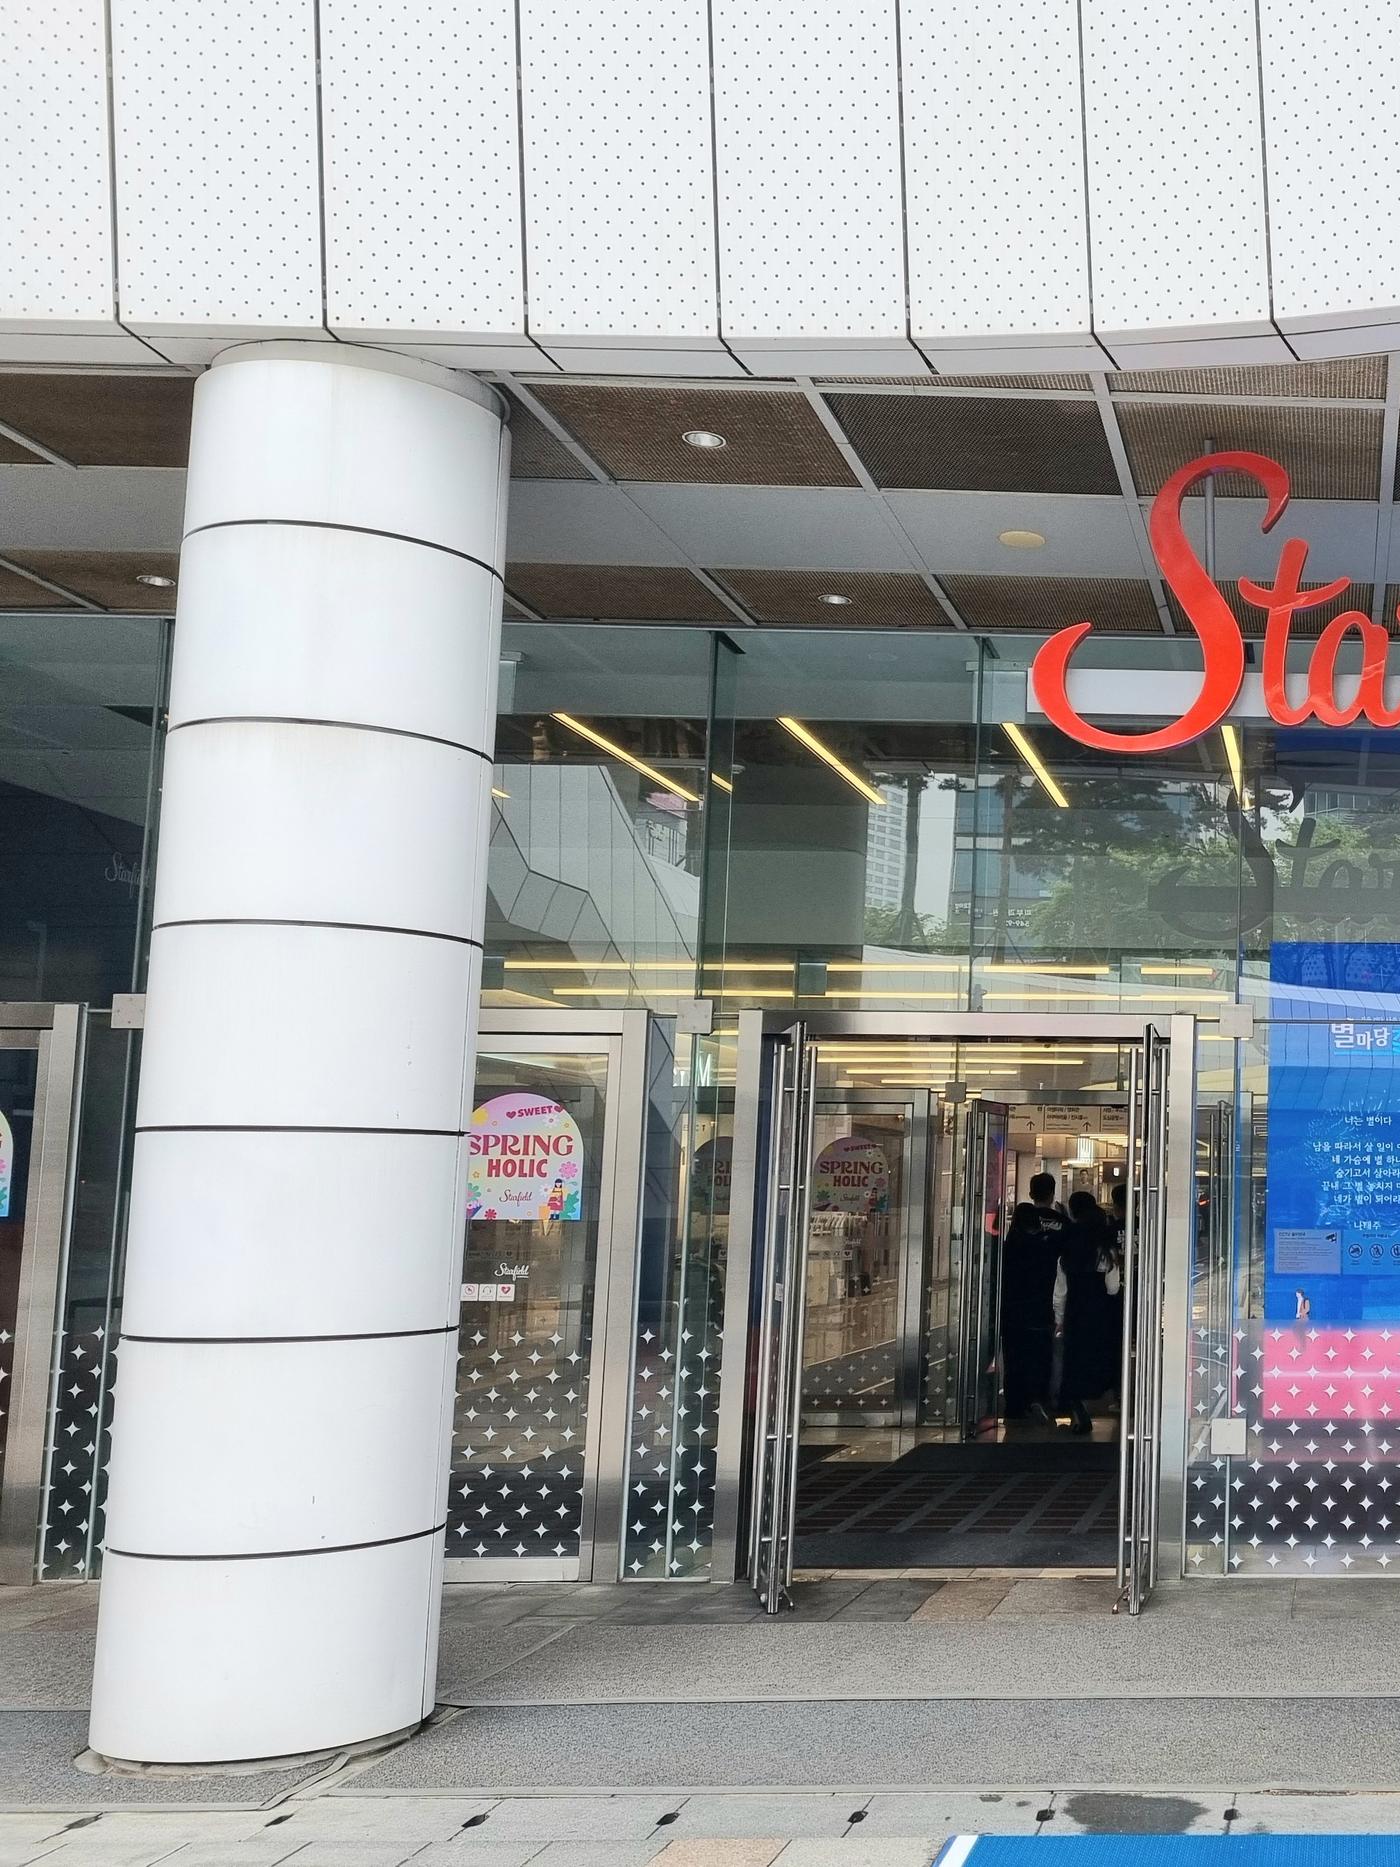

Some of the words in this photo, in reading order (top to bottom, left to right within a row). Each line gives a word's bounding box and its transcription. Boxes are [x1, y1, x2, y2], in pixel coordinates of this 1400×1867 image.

[517, 1106, 553, 1117] SWEET
[1345, 1116, 1363, 1126] 너는
[1366, 1116, 1392, 1126] 별이다
[469, 1134, 573, 1156] SPRING
[1313, 1142, 1331, 1152] 남을
[1335, 1142, 1361, 1151] 따라서
[1344, 1155, 1371, 1164] 가슴에
[487, 1159, 548, 1178] HOLIC
[820, 1161, 883, 1174] SPRING
[1373, 1168, 1400, 1178] 살아라
[833, 1175, 869, 1187] HOLIC
[499, 1189, 533, 1206] Starfield
[495, 1263, 529, 1281] Starfield
